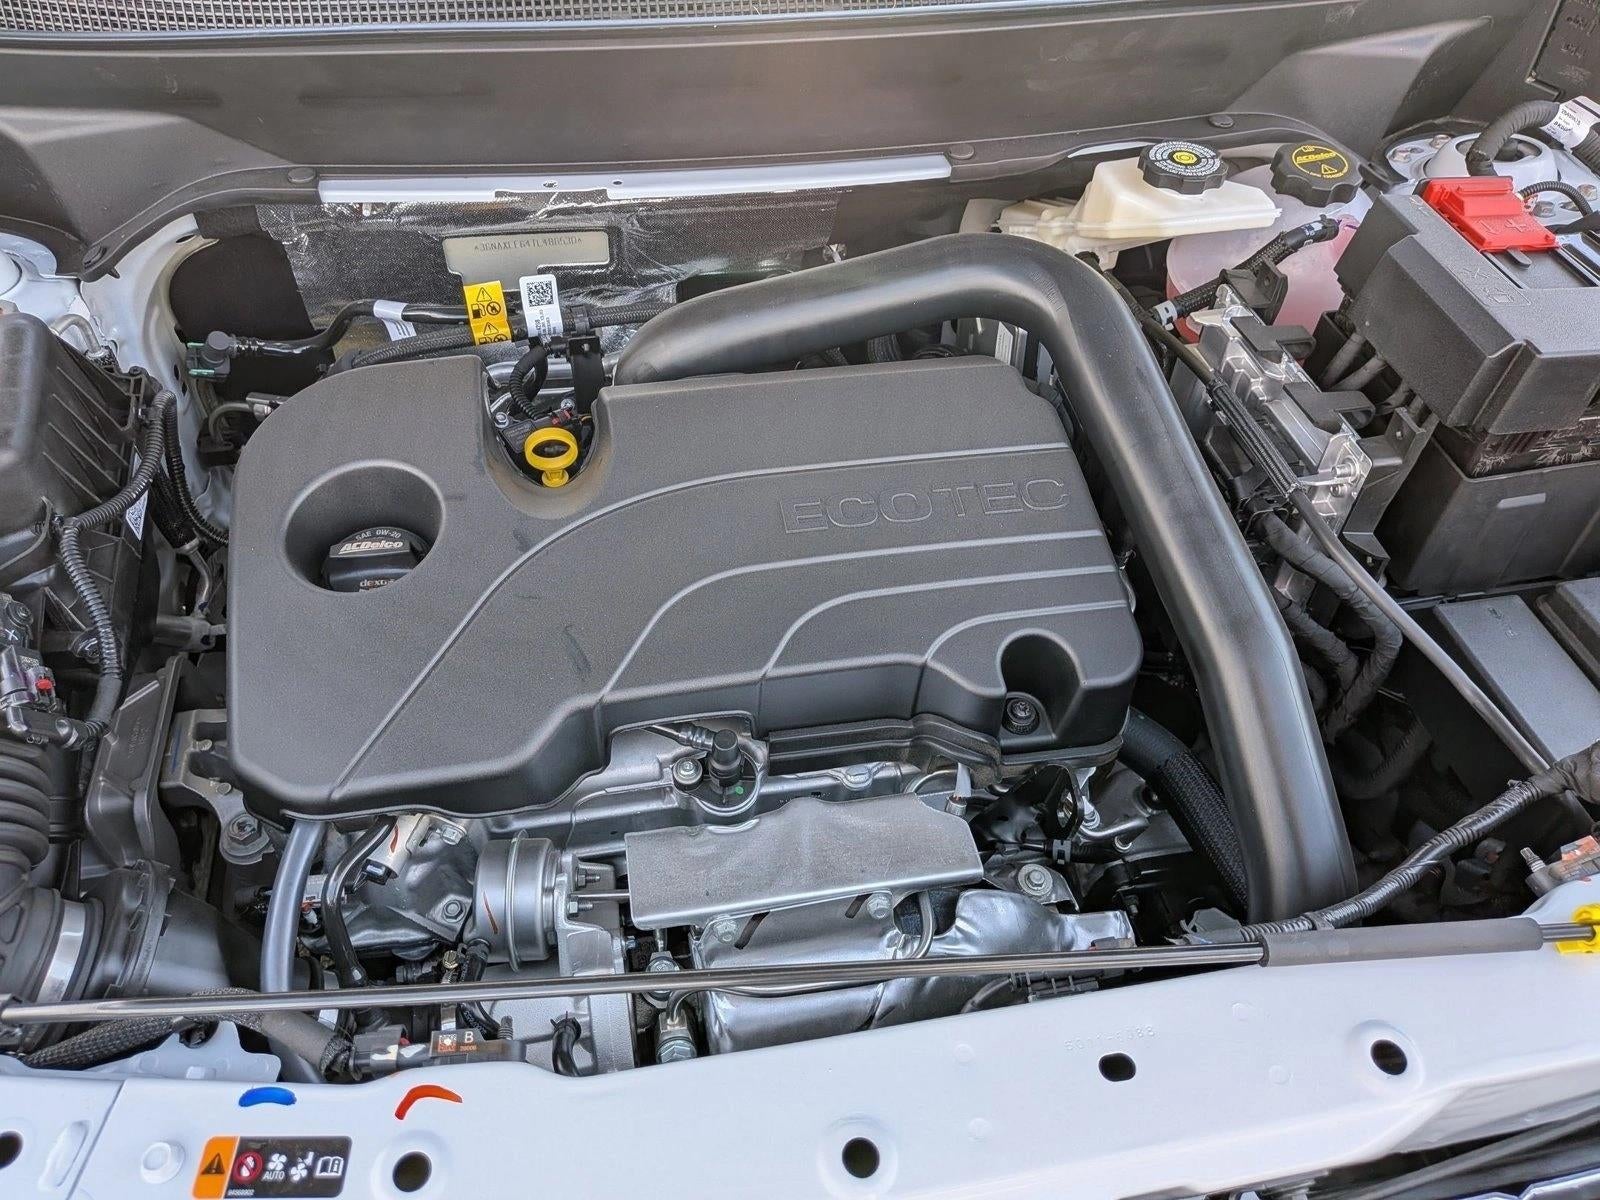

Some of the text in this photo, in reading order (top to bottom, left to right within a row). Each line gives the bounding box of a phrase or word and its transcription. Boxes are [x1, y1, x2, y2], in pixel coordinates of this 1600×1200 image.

[779, 479, 1069, 534] ECOTEC
[355, 529, 401, 541] SAE 0W-20
[338, 540, 403, 554] ACDelco
[360, 579, 396, 590] dexo
[464, 1030, 475, 1044] B
[262, 1170, 286, 1182] AUTO
